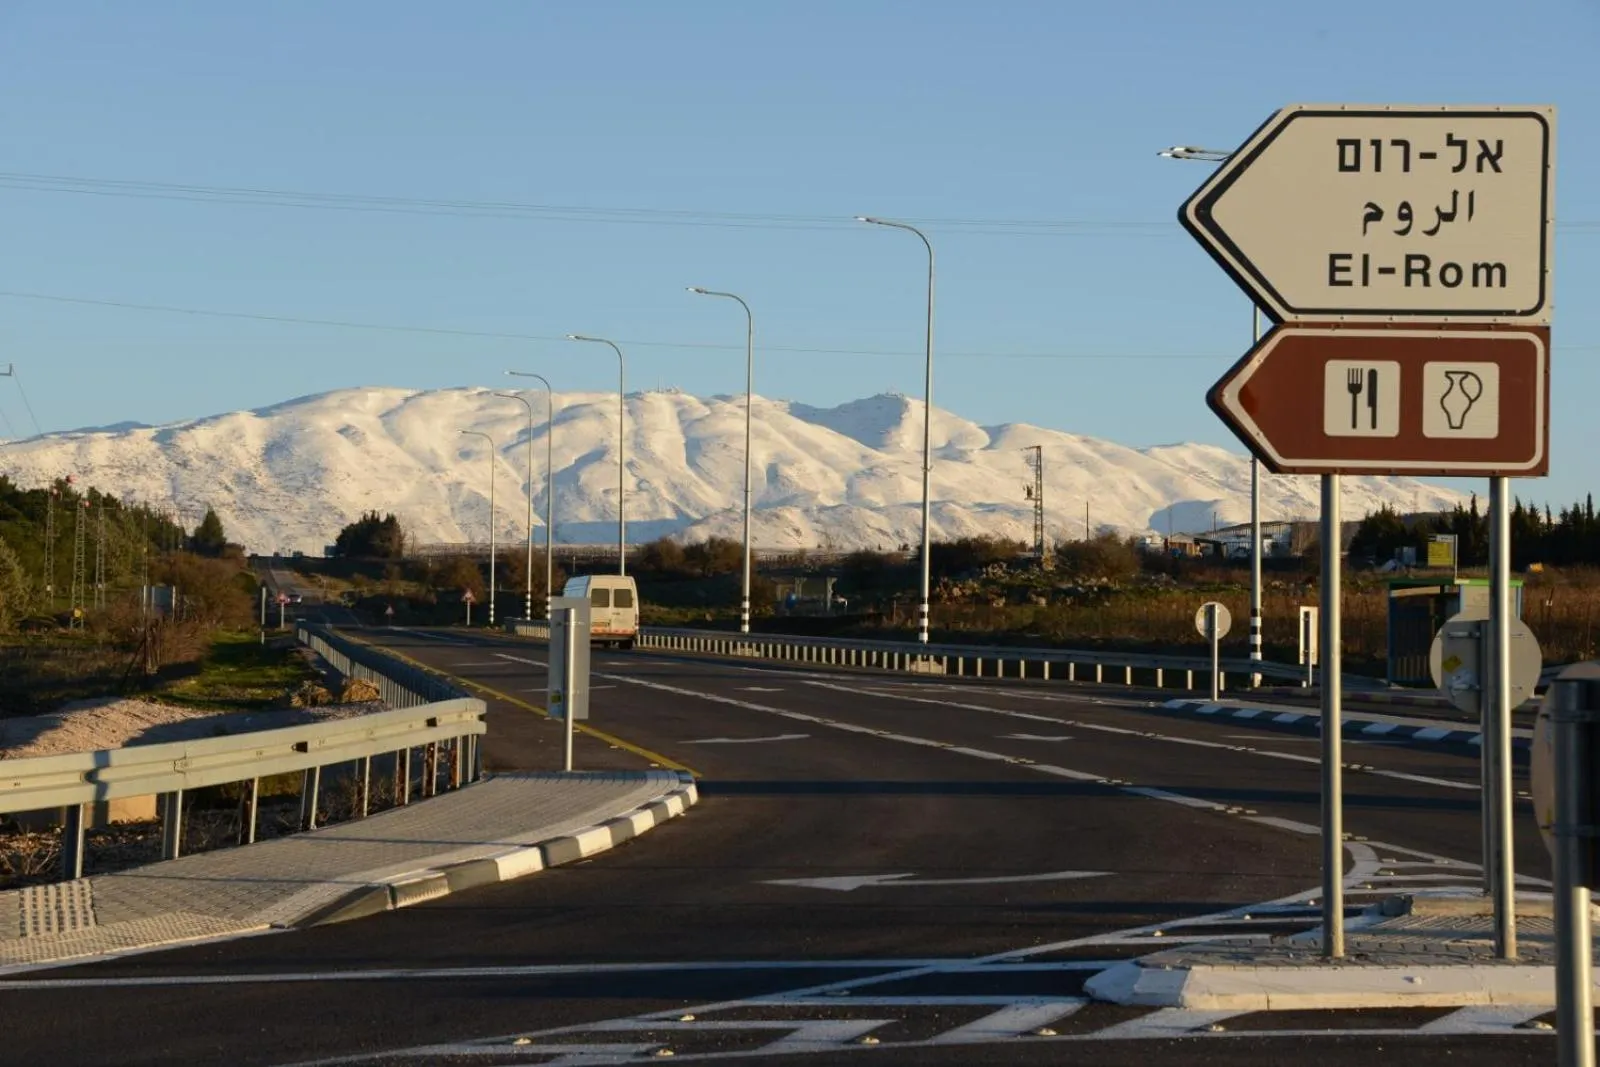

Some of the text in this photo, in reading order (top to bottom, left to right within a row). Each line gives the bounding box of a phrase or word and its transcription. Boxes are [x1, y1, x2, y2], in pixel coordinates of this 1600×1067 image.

[1336, 133, 1504, 174] אל-רום
[1362, 189, 1475, 237] الروم
[1328, 253, 1507, 289] El-Rom
